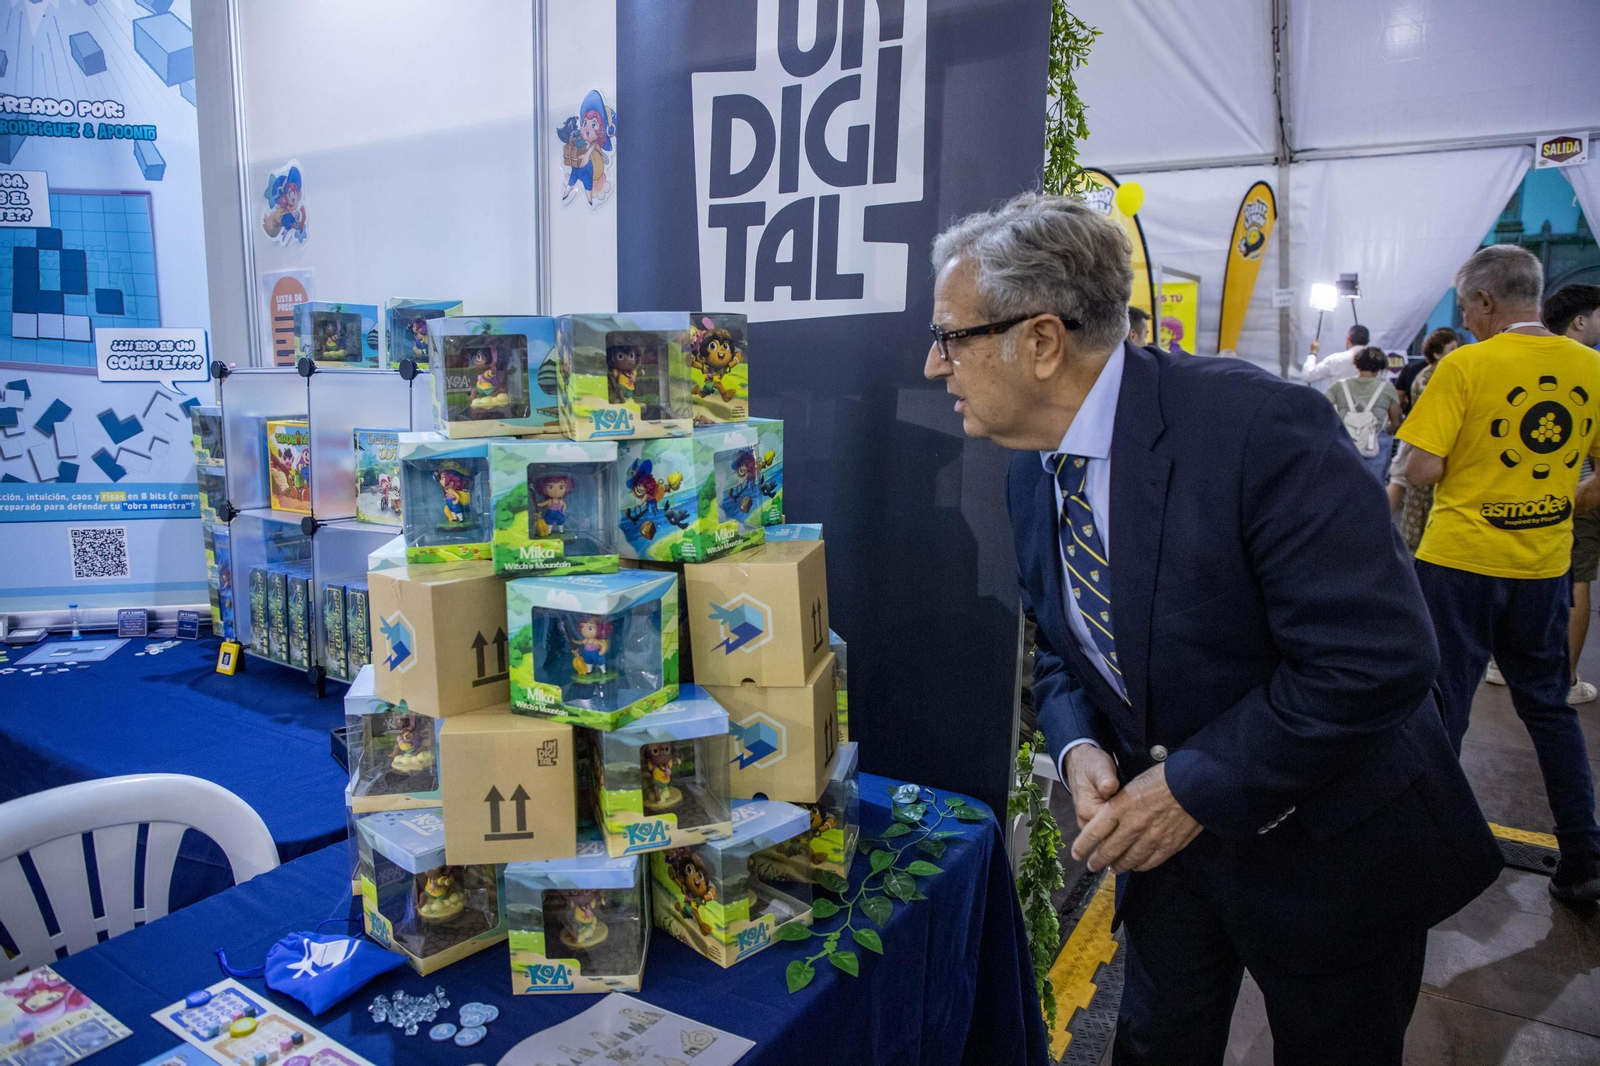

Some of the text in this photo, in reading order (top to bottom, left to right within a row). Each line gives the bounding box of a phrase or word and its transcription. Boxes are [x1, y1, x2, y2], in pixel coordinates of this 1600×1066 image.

[0, 95, 126, 119] READO POR:
[83, 122, 96, 138] &
[708, 44, 904, 200] DIGI
[1542, 140, 1581, 156] SALIDA
[0, 173, 29, 190] GA,
[9, 190, 30, 206] EL
[707, 193, 865, 303] TAL
[276, 293, 303, 304] LISTA DE
[158, 339, 175, 352] ES
[175, 339, 196, 352] UN
[107, 354, 204, 370] COHETE!!??
[590, 407, 631, 431] KOA
[26, 492, 69, 502] intuición,
[71, 493, 92, 501] caos
[94, 493, 101, 502] y
[102, 492, 126, 501] risas
[140, 492, 148, 500] 8
[149, 491, 167, 500] bits
[43, 503, 65, 512] para
[67, 502, 107, 511] defender
[110, 502, 121, 510] tu
[1480, 494, 1569, 518] asmodee
[715, 527, 736, 543] Mika
[520, 545, 556, 560] Mika
[504, 560, 571, 571] Witch's Mountain
[527, 687, 556, 704] Mika
[515, 699, 569, 717] Witch's Mountain
[624, 819, 667, 846] KOA
[737, 921, 768, 952] KOA
[526, 963, 569, 985] KOA
